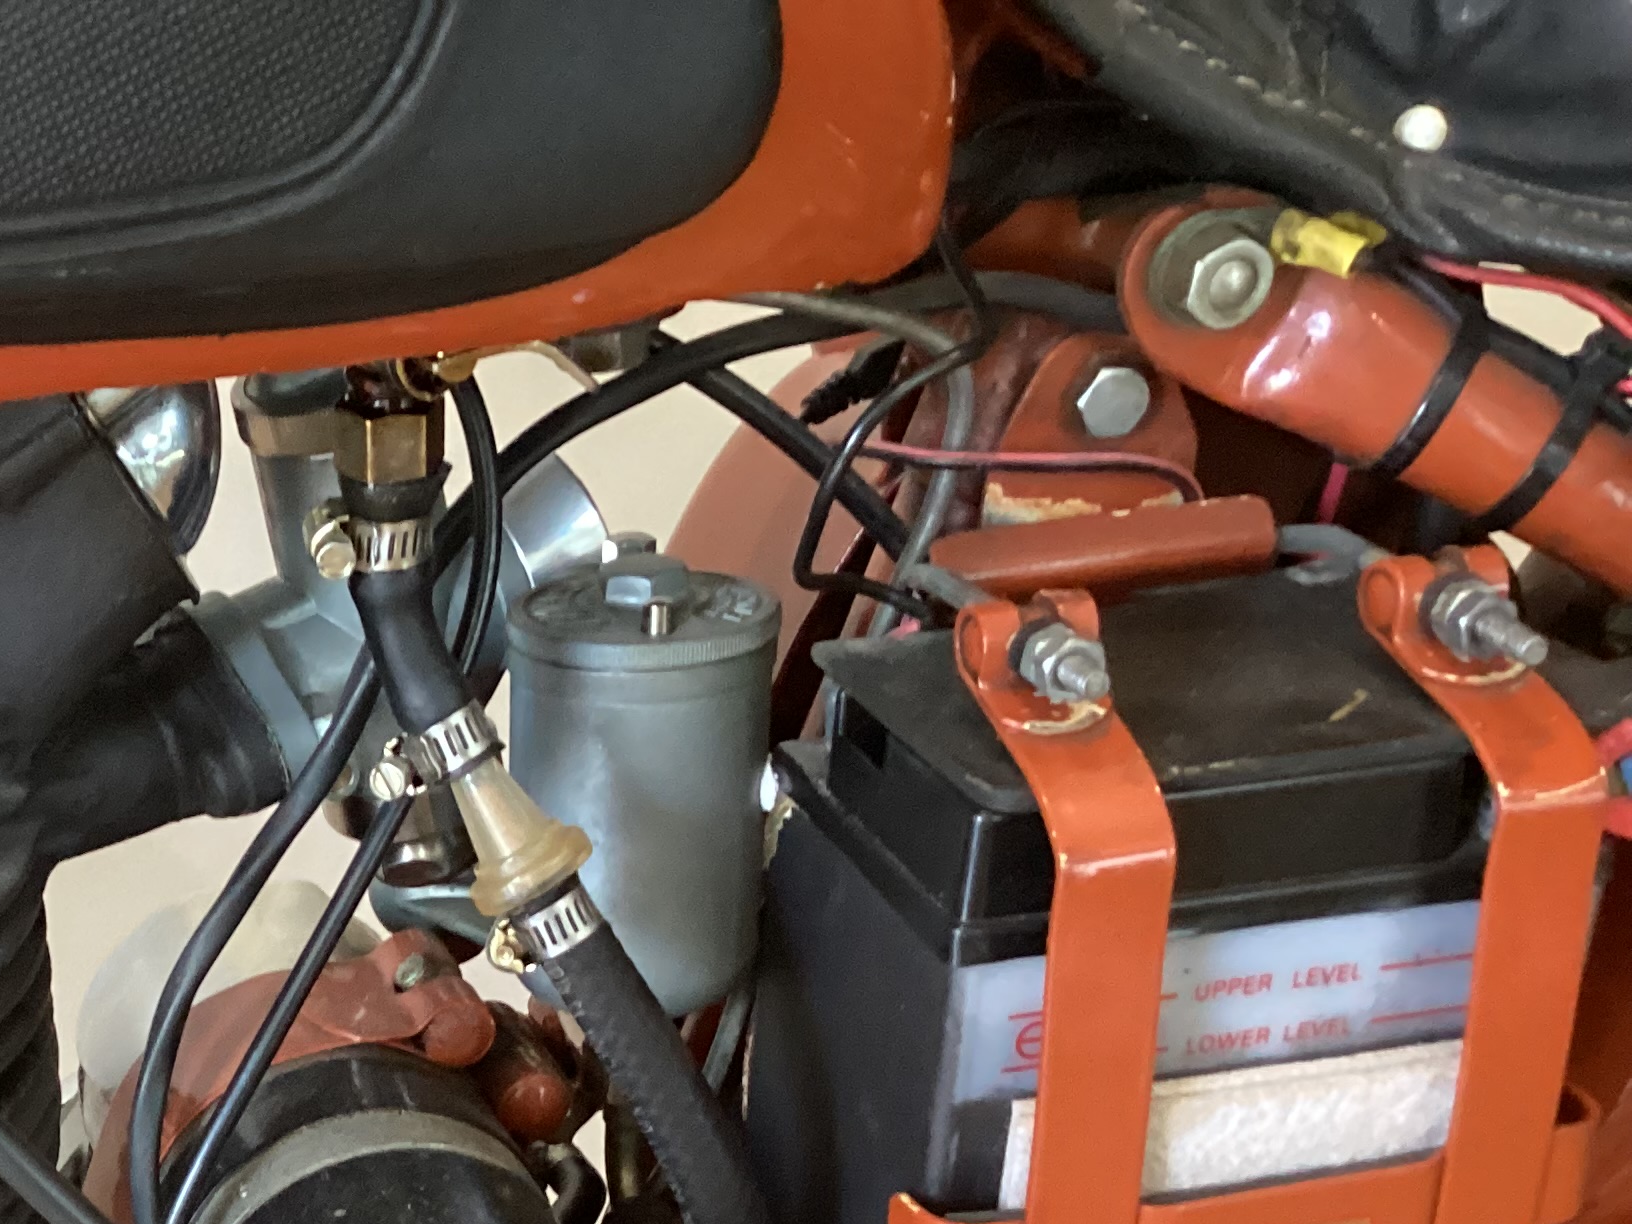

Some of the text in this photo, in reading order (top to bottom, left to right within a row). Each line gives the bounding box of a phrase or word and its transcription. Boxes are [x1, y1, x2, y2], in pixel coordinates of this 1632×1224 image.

[1194, 962, 1361, 1002] UPPER LEVEL
[1186, 1015, 1351, 1055] LOWER LEVEL
